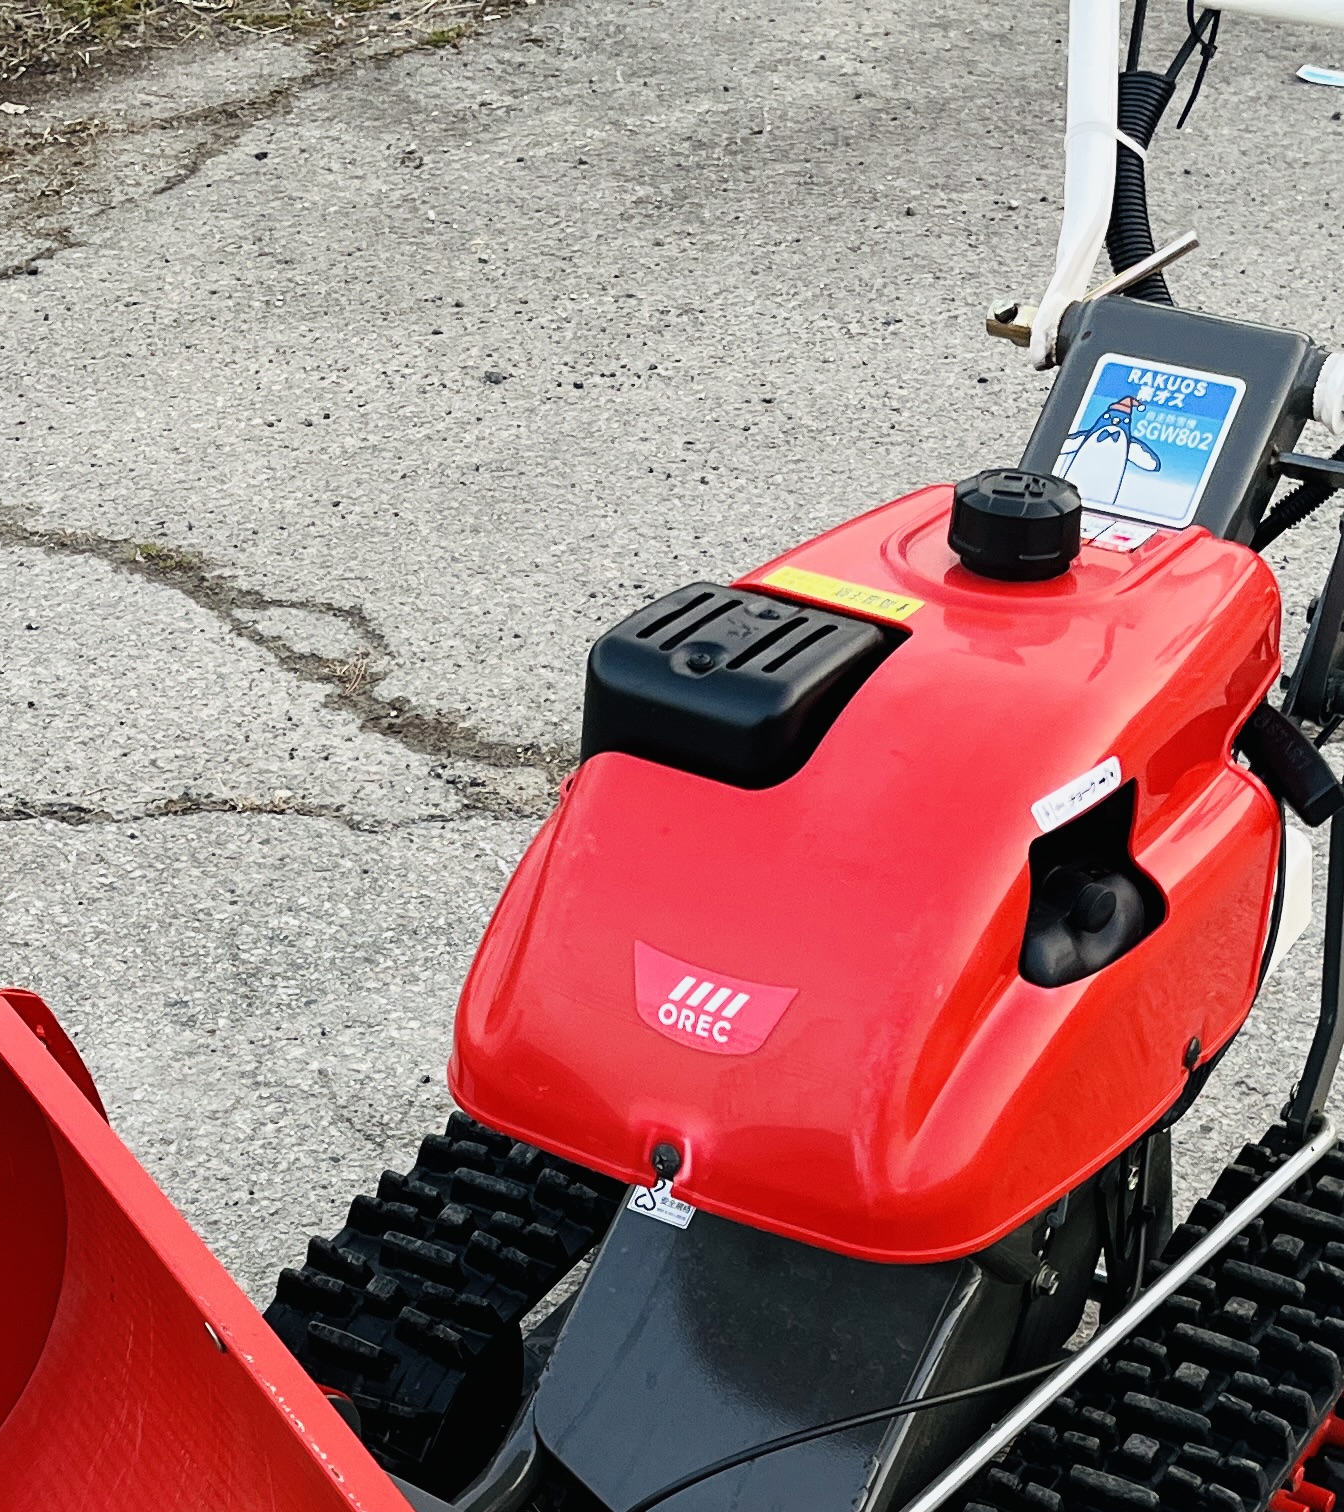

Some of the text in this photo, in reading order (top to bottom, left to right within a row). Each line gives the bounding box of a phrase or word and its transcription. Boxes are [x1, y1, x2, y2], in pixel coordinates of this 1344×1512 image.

[1127, 367, 1208, 397] RAKUOS
[1133, 419, 1213, 451] SGW802
[657, 1003, 732, 1044] OREC
